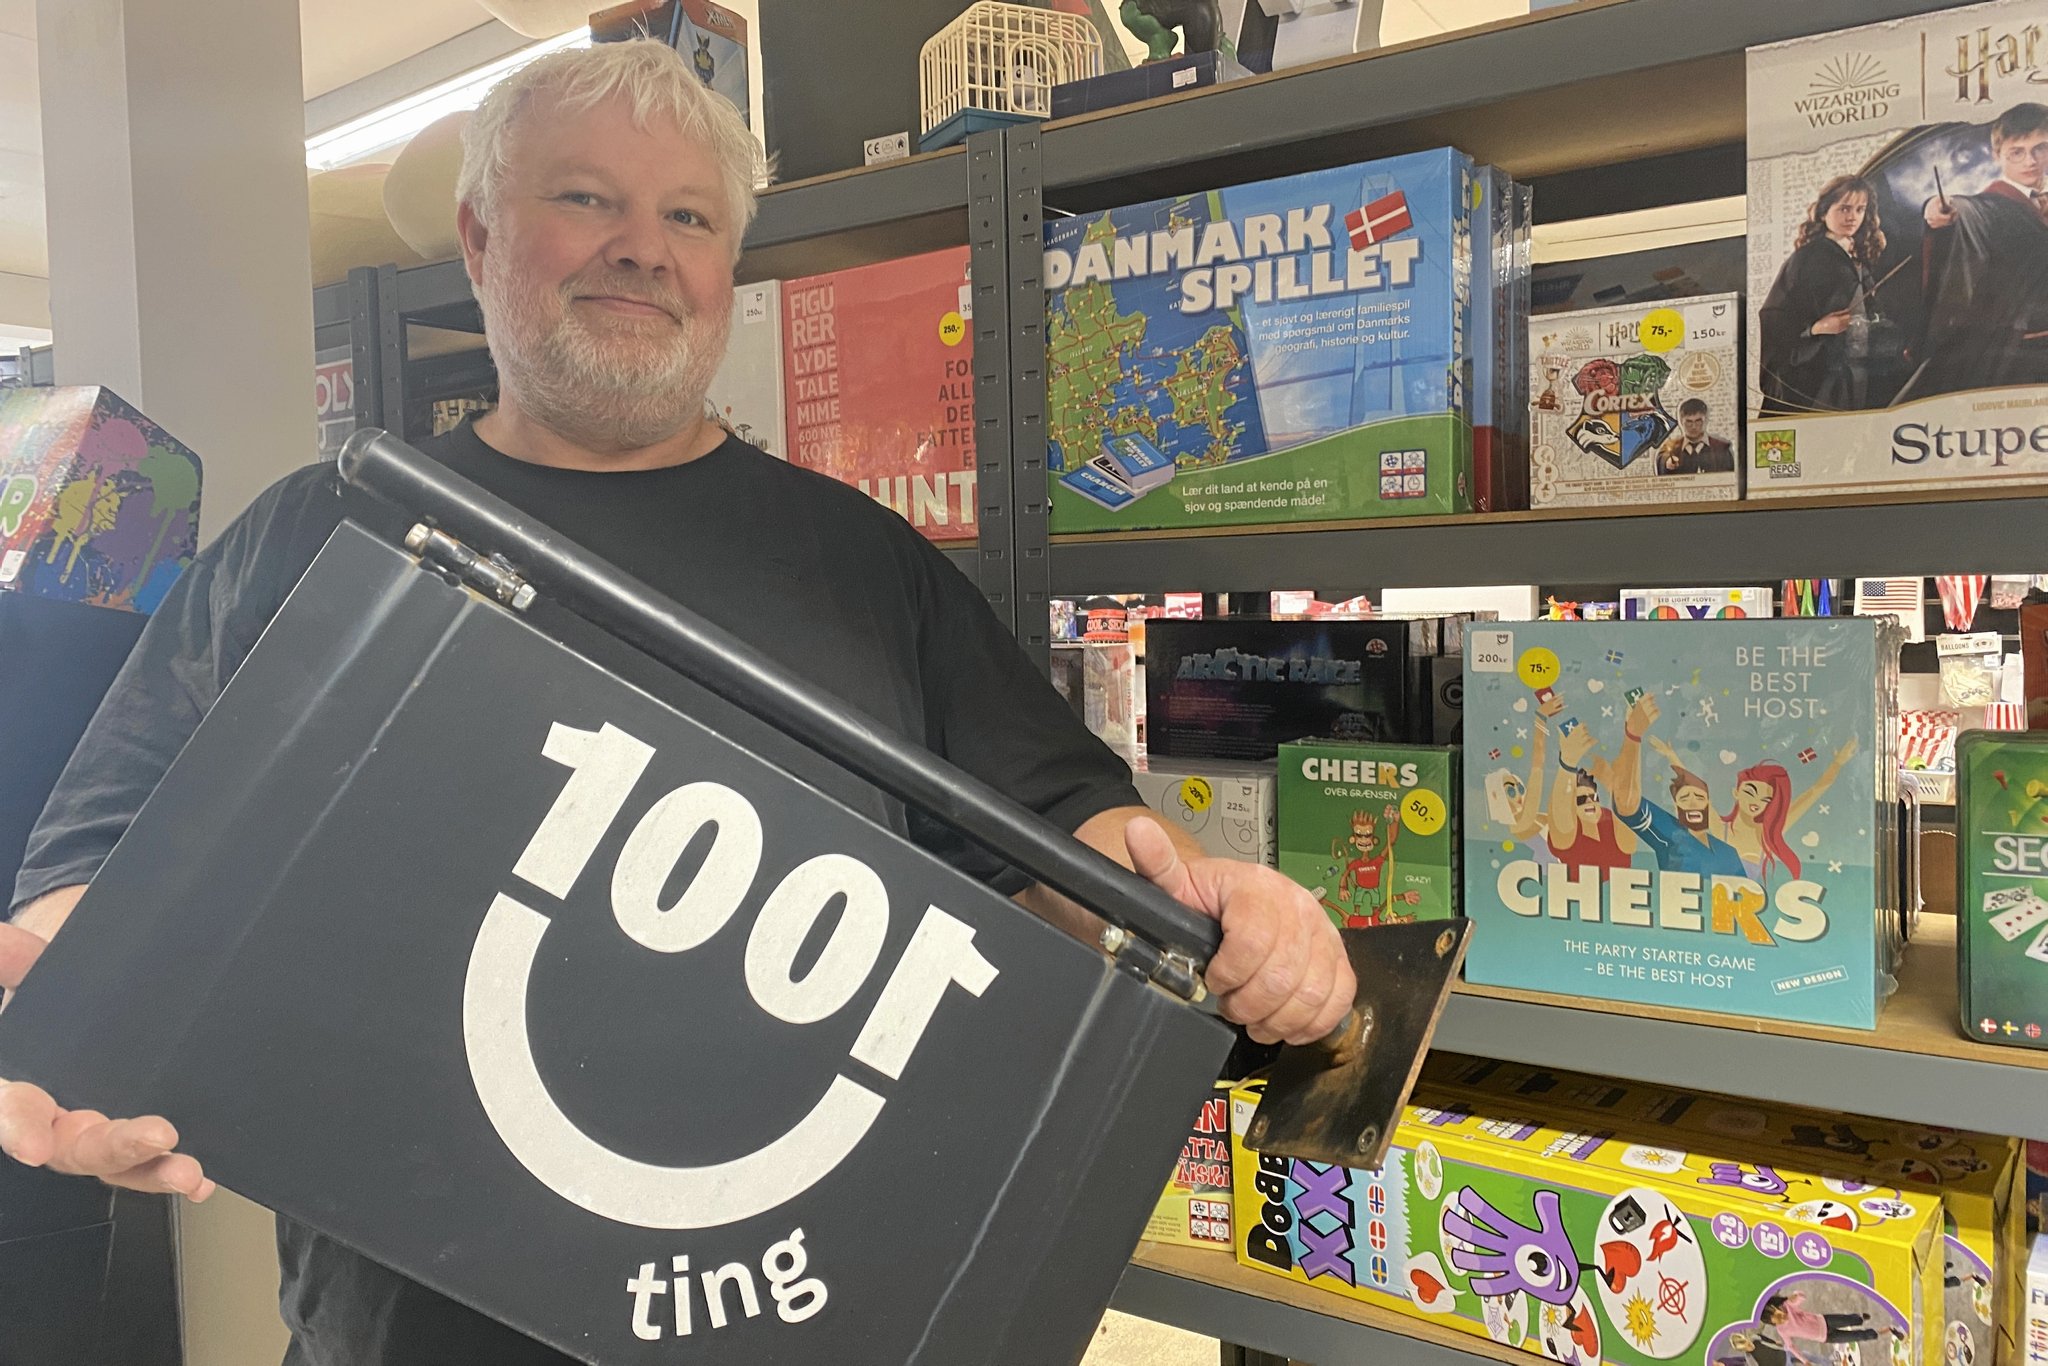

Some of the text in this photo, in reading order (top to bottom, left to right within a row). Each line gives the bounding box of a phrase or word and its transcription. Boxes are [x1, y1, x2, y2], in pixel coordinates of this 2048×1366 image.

[1794, 83, 1900, 113] WIZARDING
[1807, 102, 1889, 129] WORLD
[1043, 203, 1333, 290] DANMARK
[1180, 237, 1422, 315] SPILLET
[790, 286, 834, 319] FIGU
[1262, 319, 1271, 328] et
[1274, 316, 1297, 330] sjovt
[1300, 313, 1313, 324] og
[1316, 306, 1354, 321] lærerigt
[1358, 299, 1411, 315] familiespil
[791, 312, 836, 348] RER
[943, 324, 960, 334] 250,-
[1259, 315, 1411, 341] med spørgsmål om Danmarks
[1651, 326, 1672, 338] 75,-
[1692, 329, 1727, 341] 150kr
[1274, 330, 1411, 356] geografi, historie og kultur.
[794, 346, 838, 376] LYDE
[795, 373, 839, 400] TALE
[797, 400, 840, 425] MIME
[1584, 390, 1655, 417] CORTEX
[799, 429, 818, 443] 600
[821, 425, 842, 439] NYE
[1891, 421, 2048, 467] Stupe
[1770, 463, 1799, 474] REPOS
[1080, 472, 1126, 496] CHANCEN
[1182, 478, 1328, 496] Lær dit land at kende på en
[1184, 493, 1326, 514] sjov og spændende måde!
[1736, 646, 1827, 667] BE THE
[1940, 642, 1970, 651] BALLOONS
[1176, 647, 1362, 685] ARCTIC RACE
[1530, 664, 1550, 673] 75,-
[1750, 672, 1812, 693] BEST
[1302, 758, 1419, 788] CHEERS
[1188, 785, 1205, 805] -20%
[1324, 787, 1398, 800] OVER GRÆNSEN
[1410, 800, 1435, 823] 50,-
[1405, 874, 1431, 884] CRAZY!
[512, 720, 1000, 1081] 1001
[1496, 859, 1829, 947] CHEERS
[1563, 939, 1757, 972] THE PARTY STARTER GAME
[1597, 963, 1615, 977] BE
[1619, 965, 1646, 980] THE
[1651, 968, 1686, 985] BEST
[1691, 972, 1734, 990] HOST
[1776, 969, 1843, 992] NEW DESIGN
[1719, 1214, 1737, 1245] 2-8
[1801, 1239, 1820, 1261] 6+
[626, 1228, 828, 1340] ting
